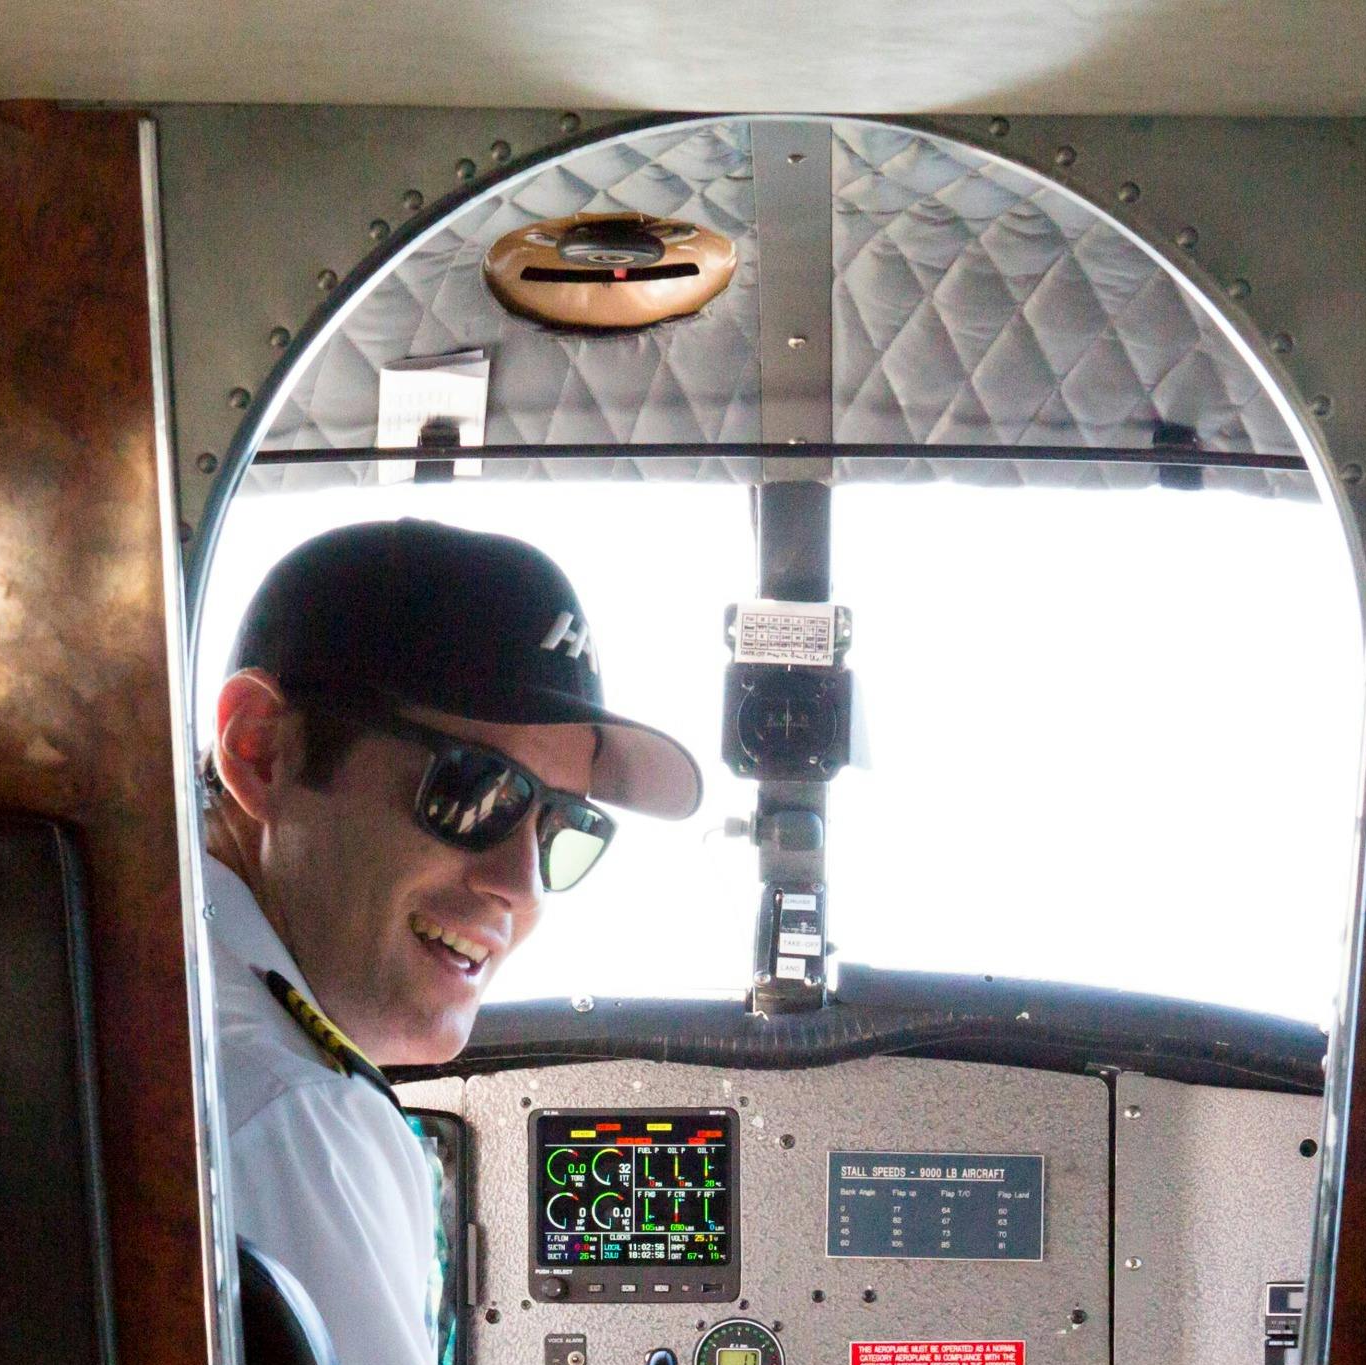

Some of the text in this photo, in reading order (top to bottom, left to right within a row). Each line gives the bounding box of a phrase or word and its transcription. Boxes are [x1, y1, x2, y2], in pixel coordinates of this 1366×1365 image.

[568, 1164, 586, 1174] 0.0
[619, 1164, 630, 1173] 32
[841, 1166, 867, 1176] STALL
[872, 1167, 906, 1177] SPEEDS
[920, 1168, 941, 1178] 9000
[946, 1169, 957, 1178] LB
[962, 1169, 1005, 1179] AIRCRAFT
[579, 1208, 586, 1217] 0
[613, 1208, 631, 1217] 0.0
[874, 1345, 909, 1353] AEROPLANE
[860, 1354, 892, 1362] CATEGORY
